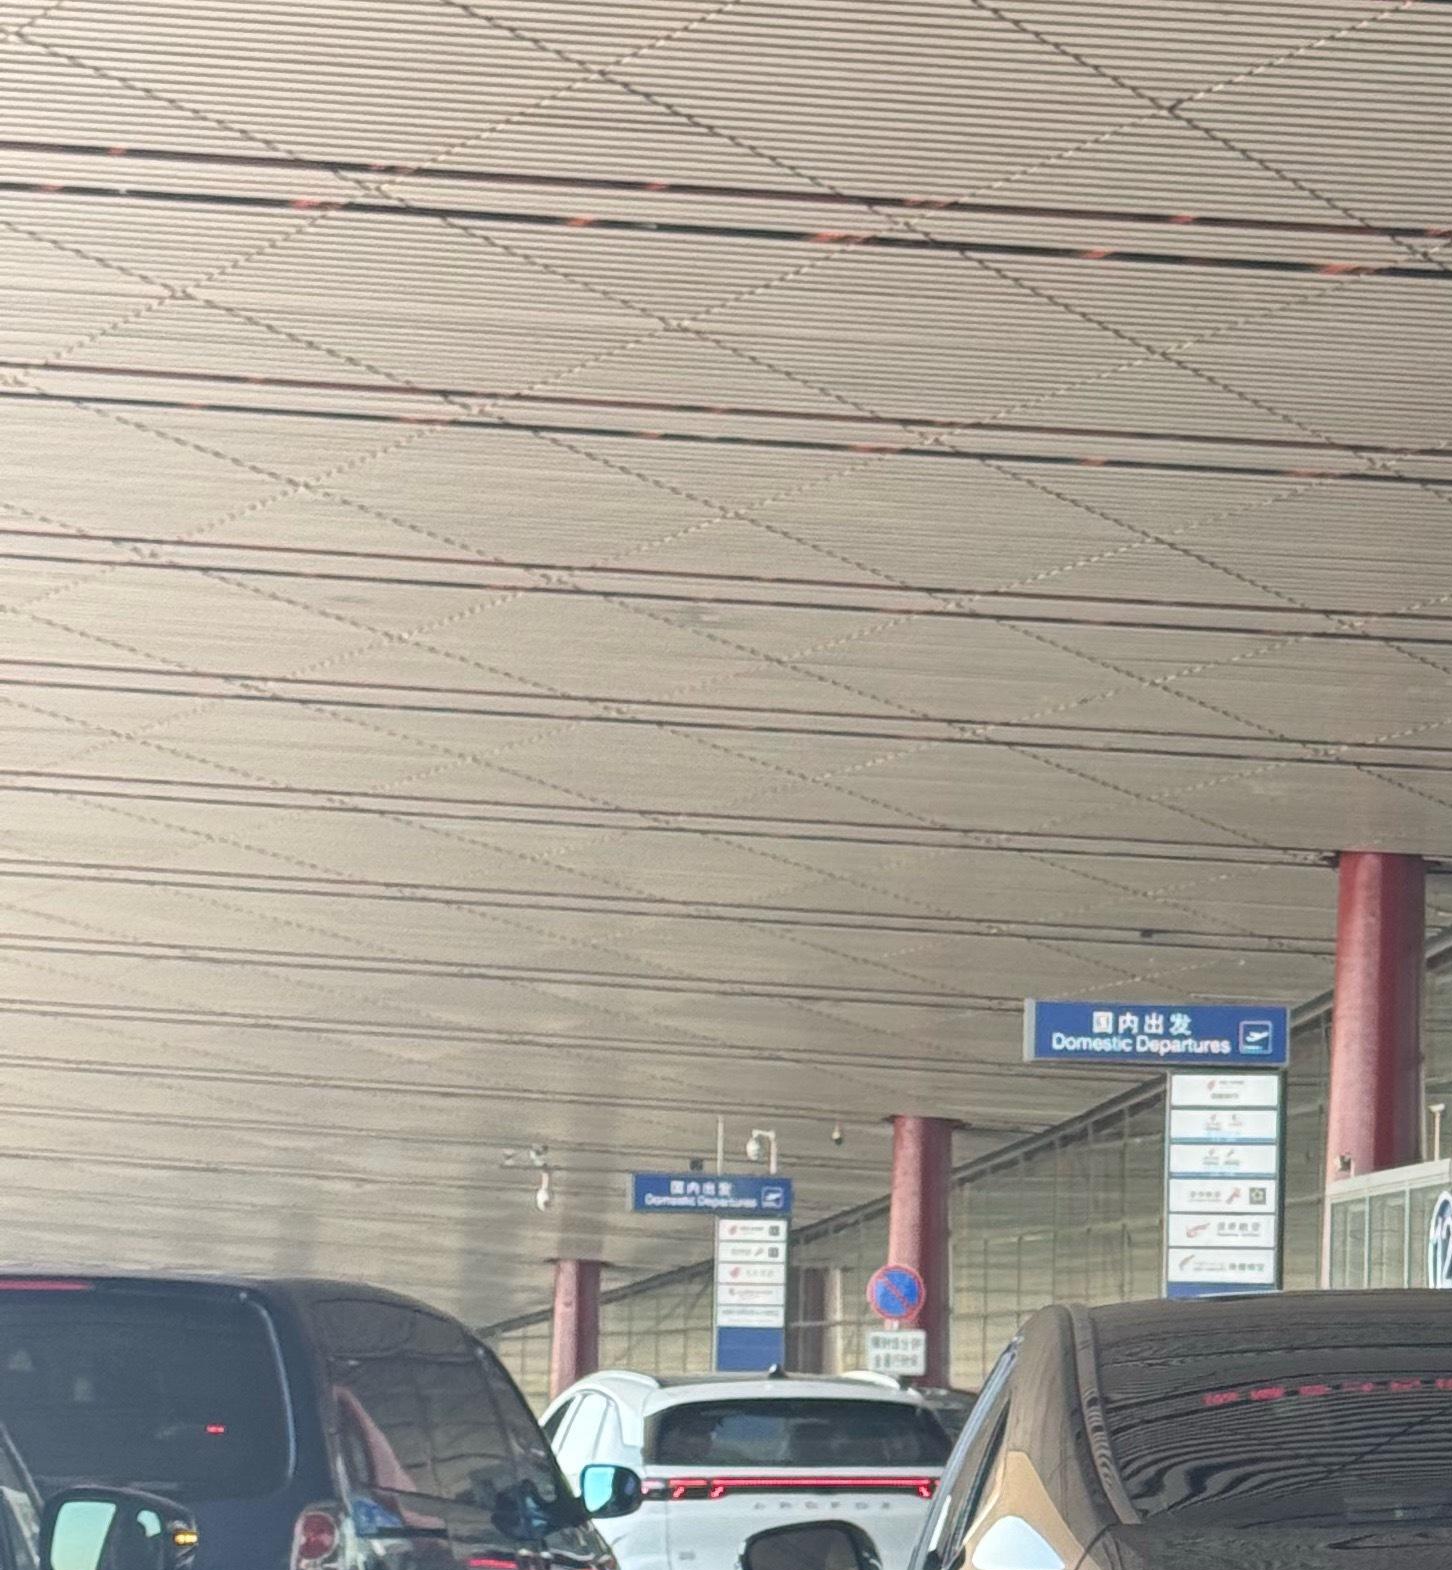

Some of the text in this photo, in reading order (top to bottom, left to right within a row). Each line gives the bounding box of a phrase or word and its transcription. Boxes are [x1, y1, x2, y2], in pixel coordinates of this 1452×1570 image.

[1092, 1011, 1192, 1036] 国内出发
[1052, 1032, 1231, 1056] Domestic Departures
